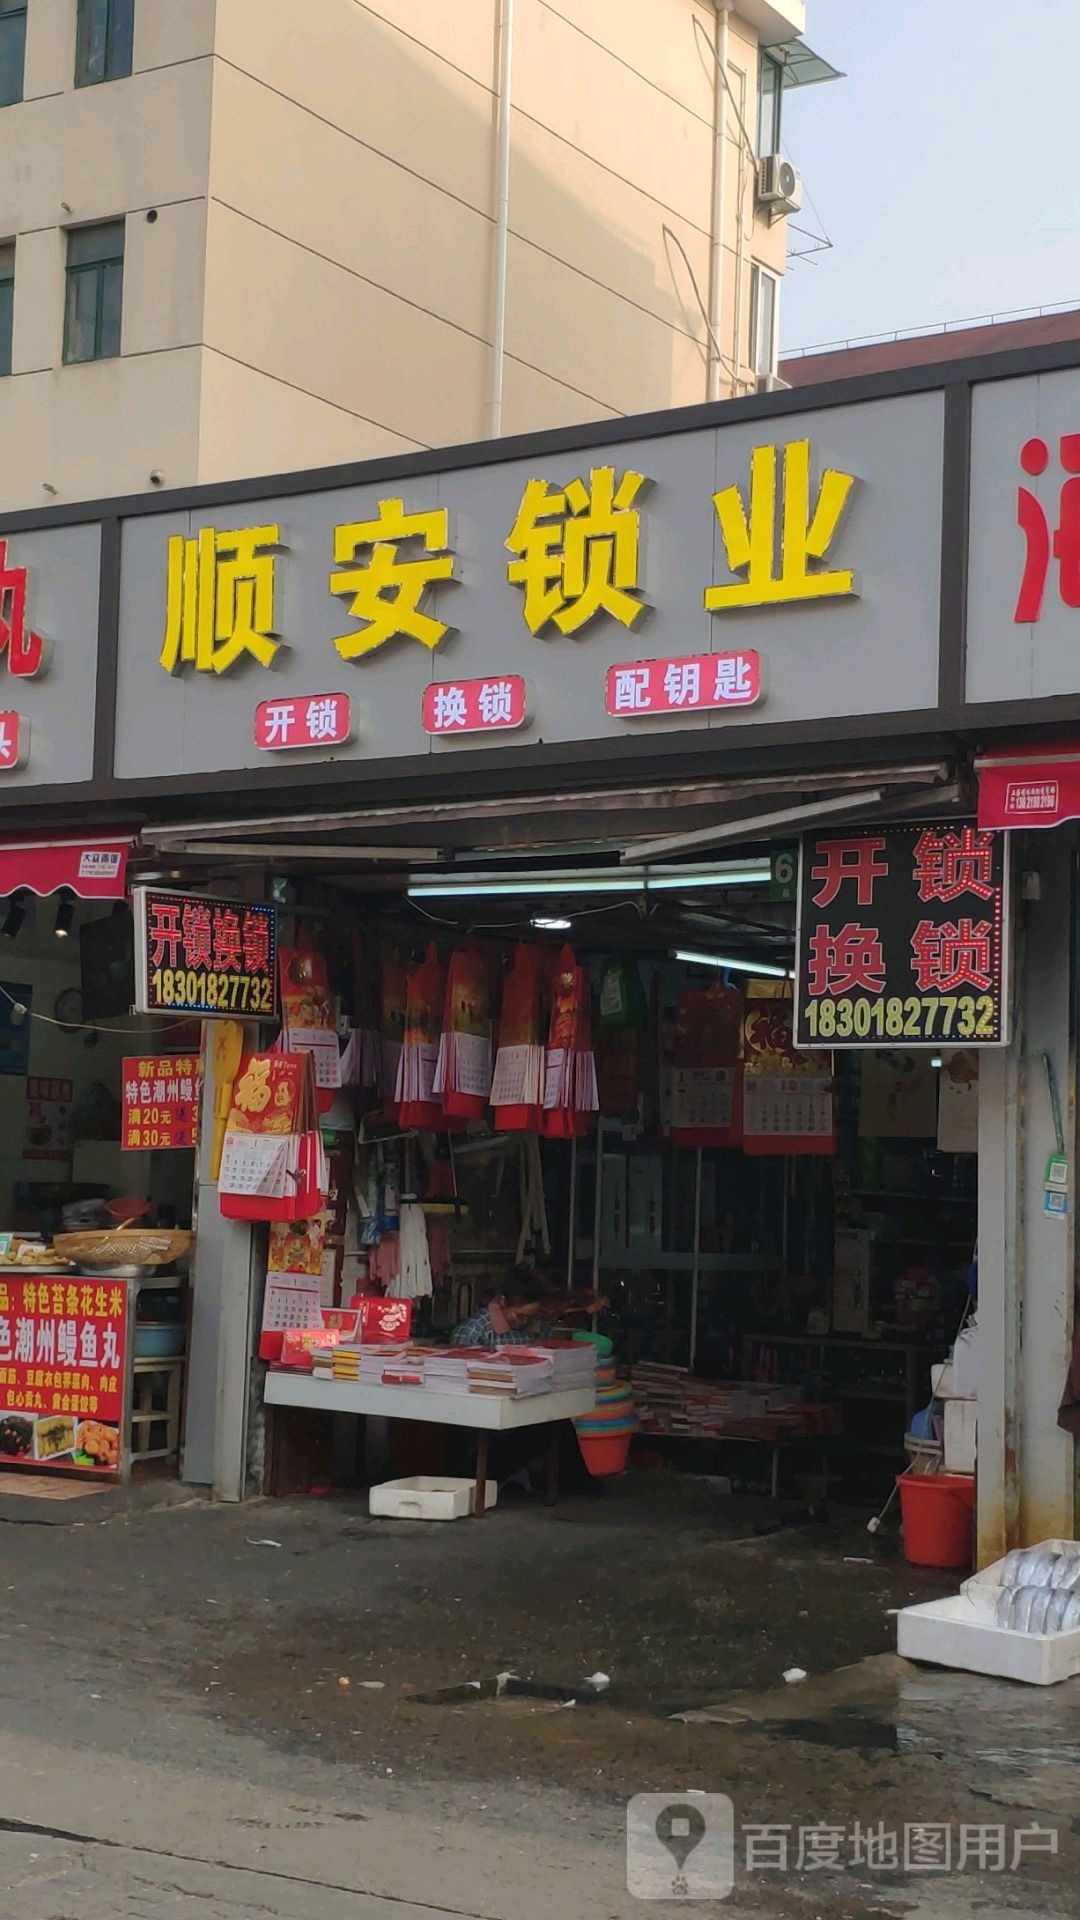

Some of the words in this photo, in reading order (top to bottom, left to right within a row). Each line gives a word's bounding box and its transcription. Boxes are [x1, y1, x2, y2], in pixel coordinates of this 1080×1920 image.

[159, 439, 855, 673] 顺安锁业
[434, 682, 513, 728] 换锁
[614, 657, 753, 709] 配钥匙
[264, 693, 338, 743] 开锁
[775, 853, 794, 884] 6
[811, 829, 995, 907] 开锁
[808, 918, 993, 995] 换锁
[151, 968, 272, 1010] 18301827732
[804, 995, 994, 1038] 18301827732
